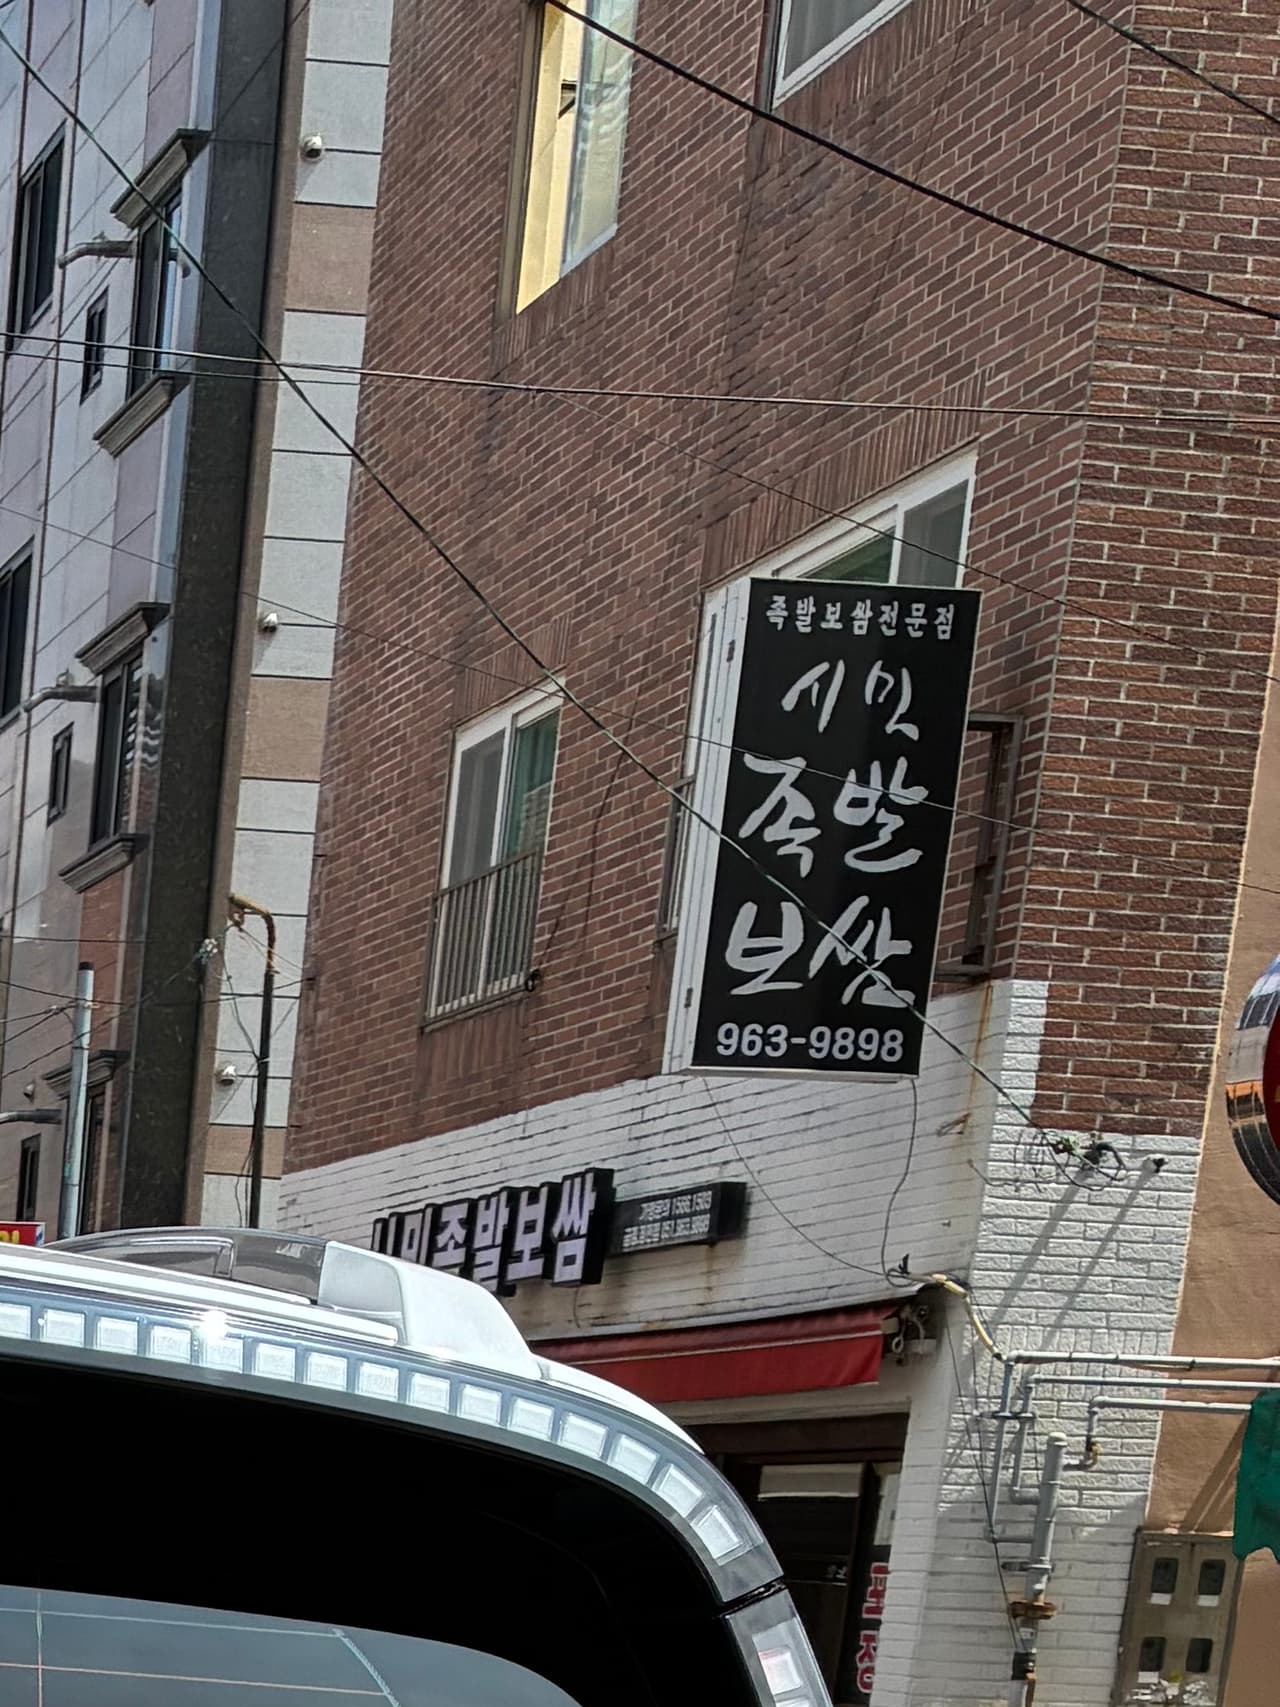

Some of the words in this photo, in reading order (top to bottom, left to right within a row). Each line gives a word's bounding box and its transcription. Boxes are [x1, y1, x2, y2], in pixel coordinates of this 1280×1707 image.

[765, 594, 955, 640] 족발보쌈전문점
[738, 753, 929, 879] 족발
[725, 895, 916, 1009] 보쌈
[715, 1022, 905, 1063] 963-9898
